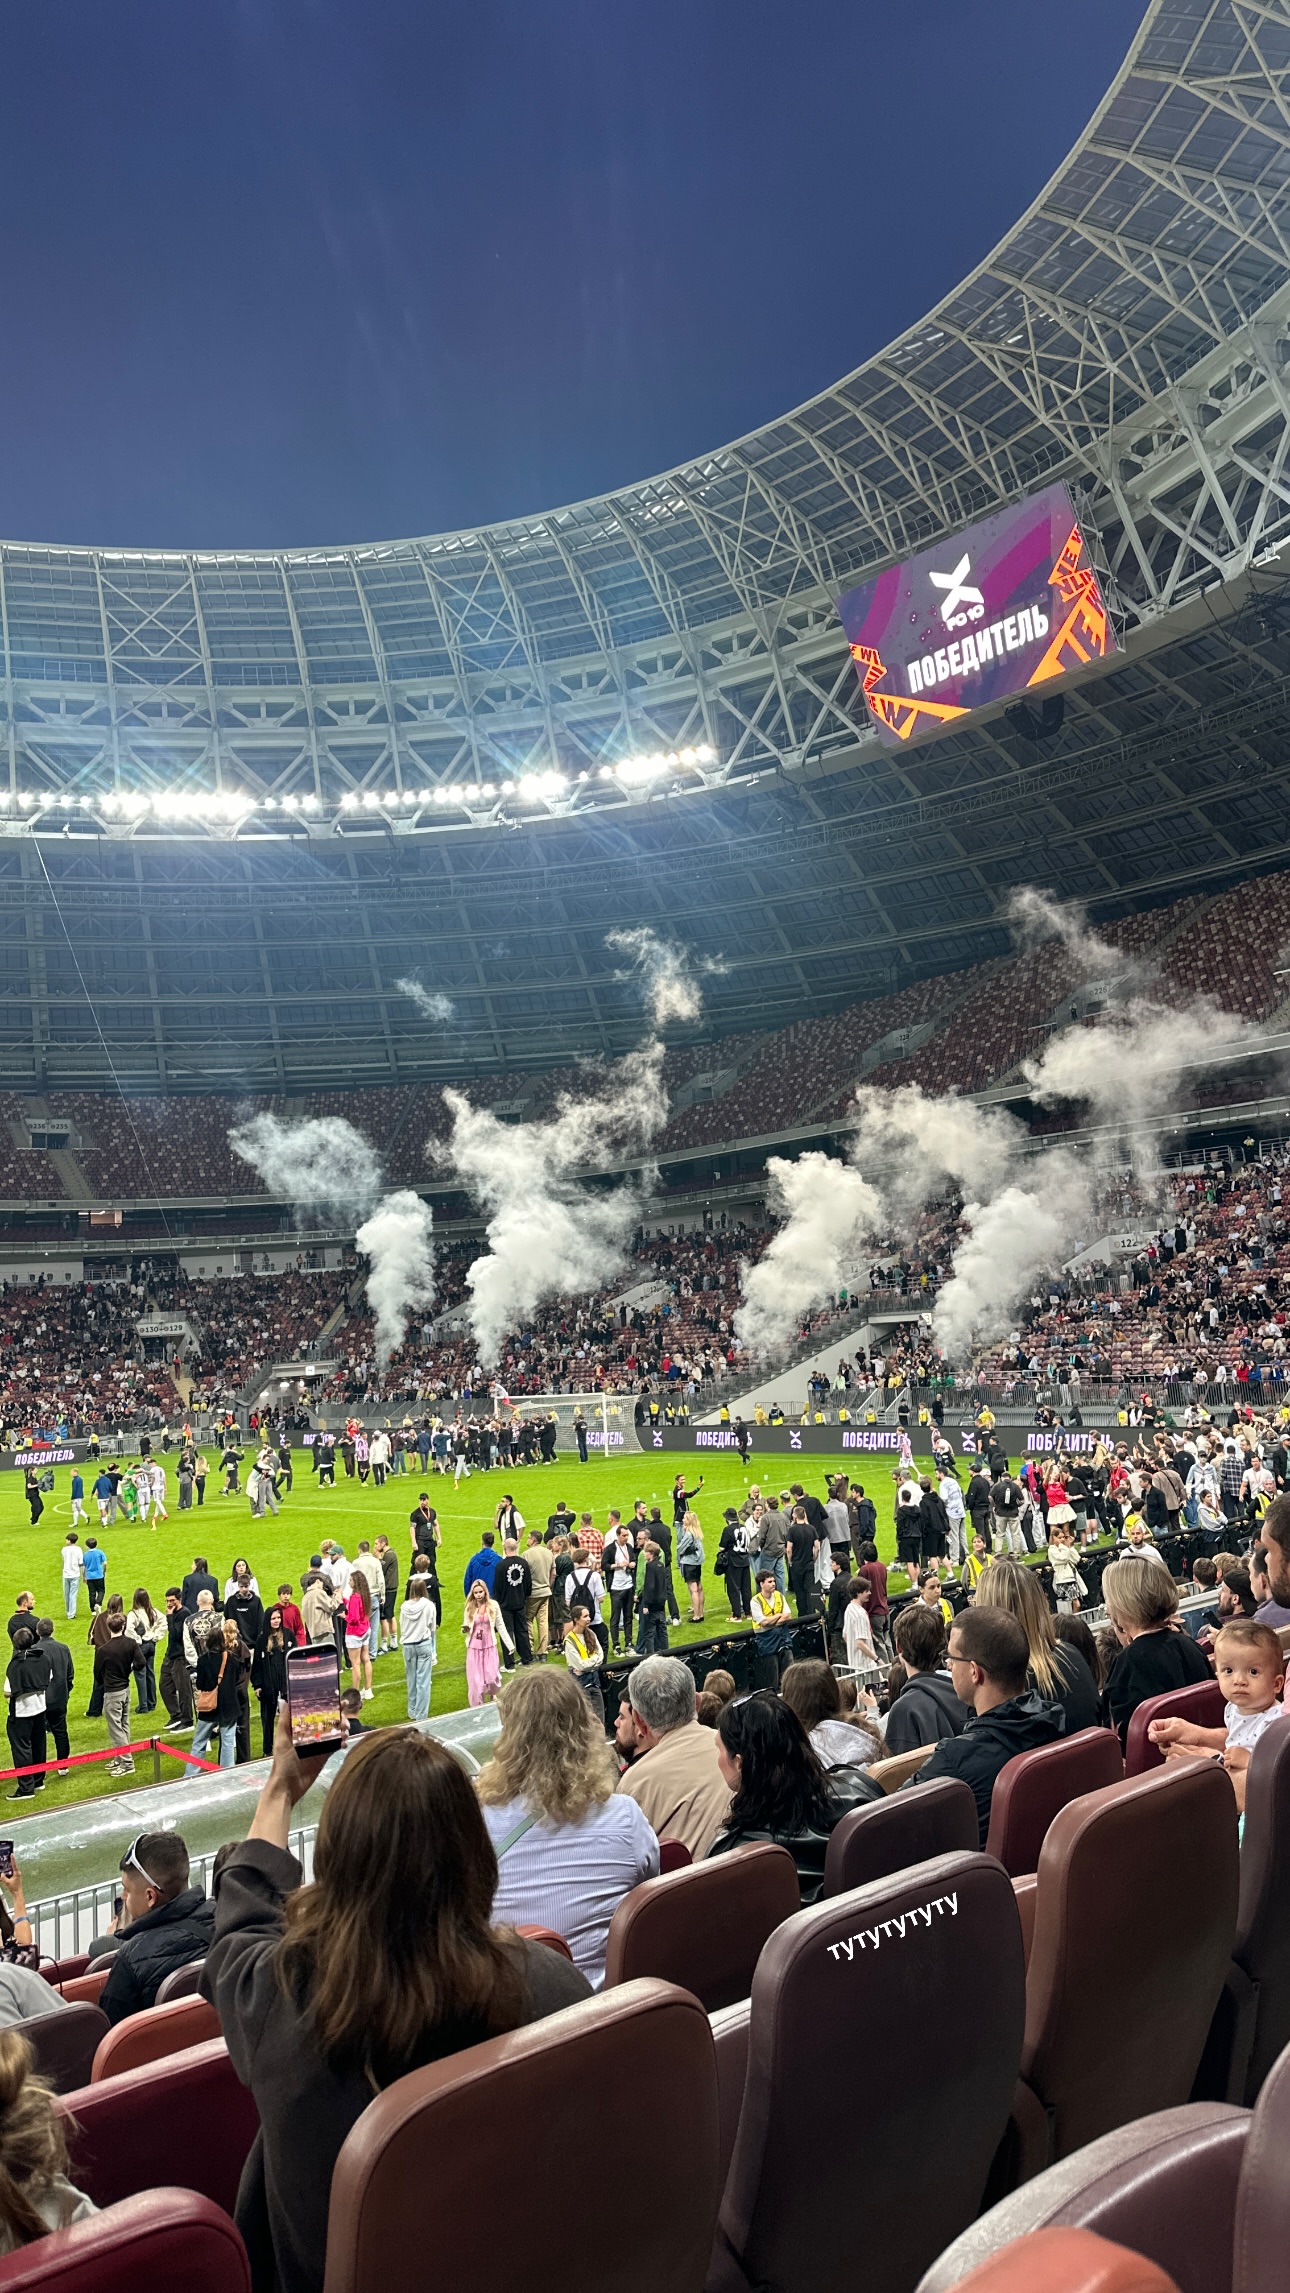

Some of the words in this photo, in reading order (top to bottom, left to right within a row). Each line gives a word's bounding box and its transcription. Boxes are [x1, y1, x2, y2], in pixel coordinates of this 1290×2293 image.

[907, 605, 1049, 694] ПОБЕДИТЕЛЬ
[169, 1324, 183, 1332] 129
[695, 1431, 753, 1449] ПОБЕДИТЕЬ
[1027, 1433, 1115, 1452] ПОБДИТЕЬ
[14, 1448, 75, 1466] ПОБЕДИТЕЛЬ
